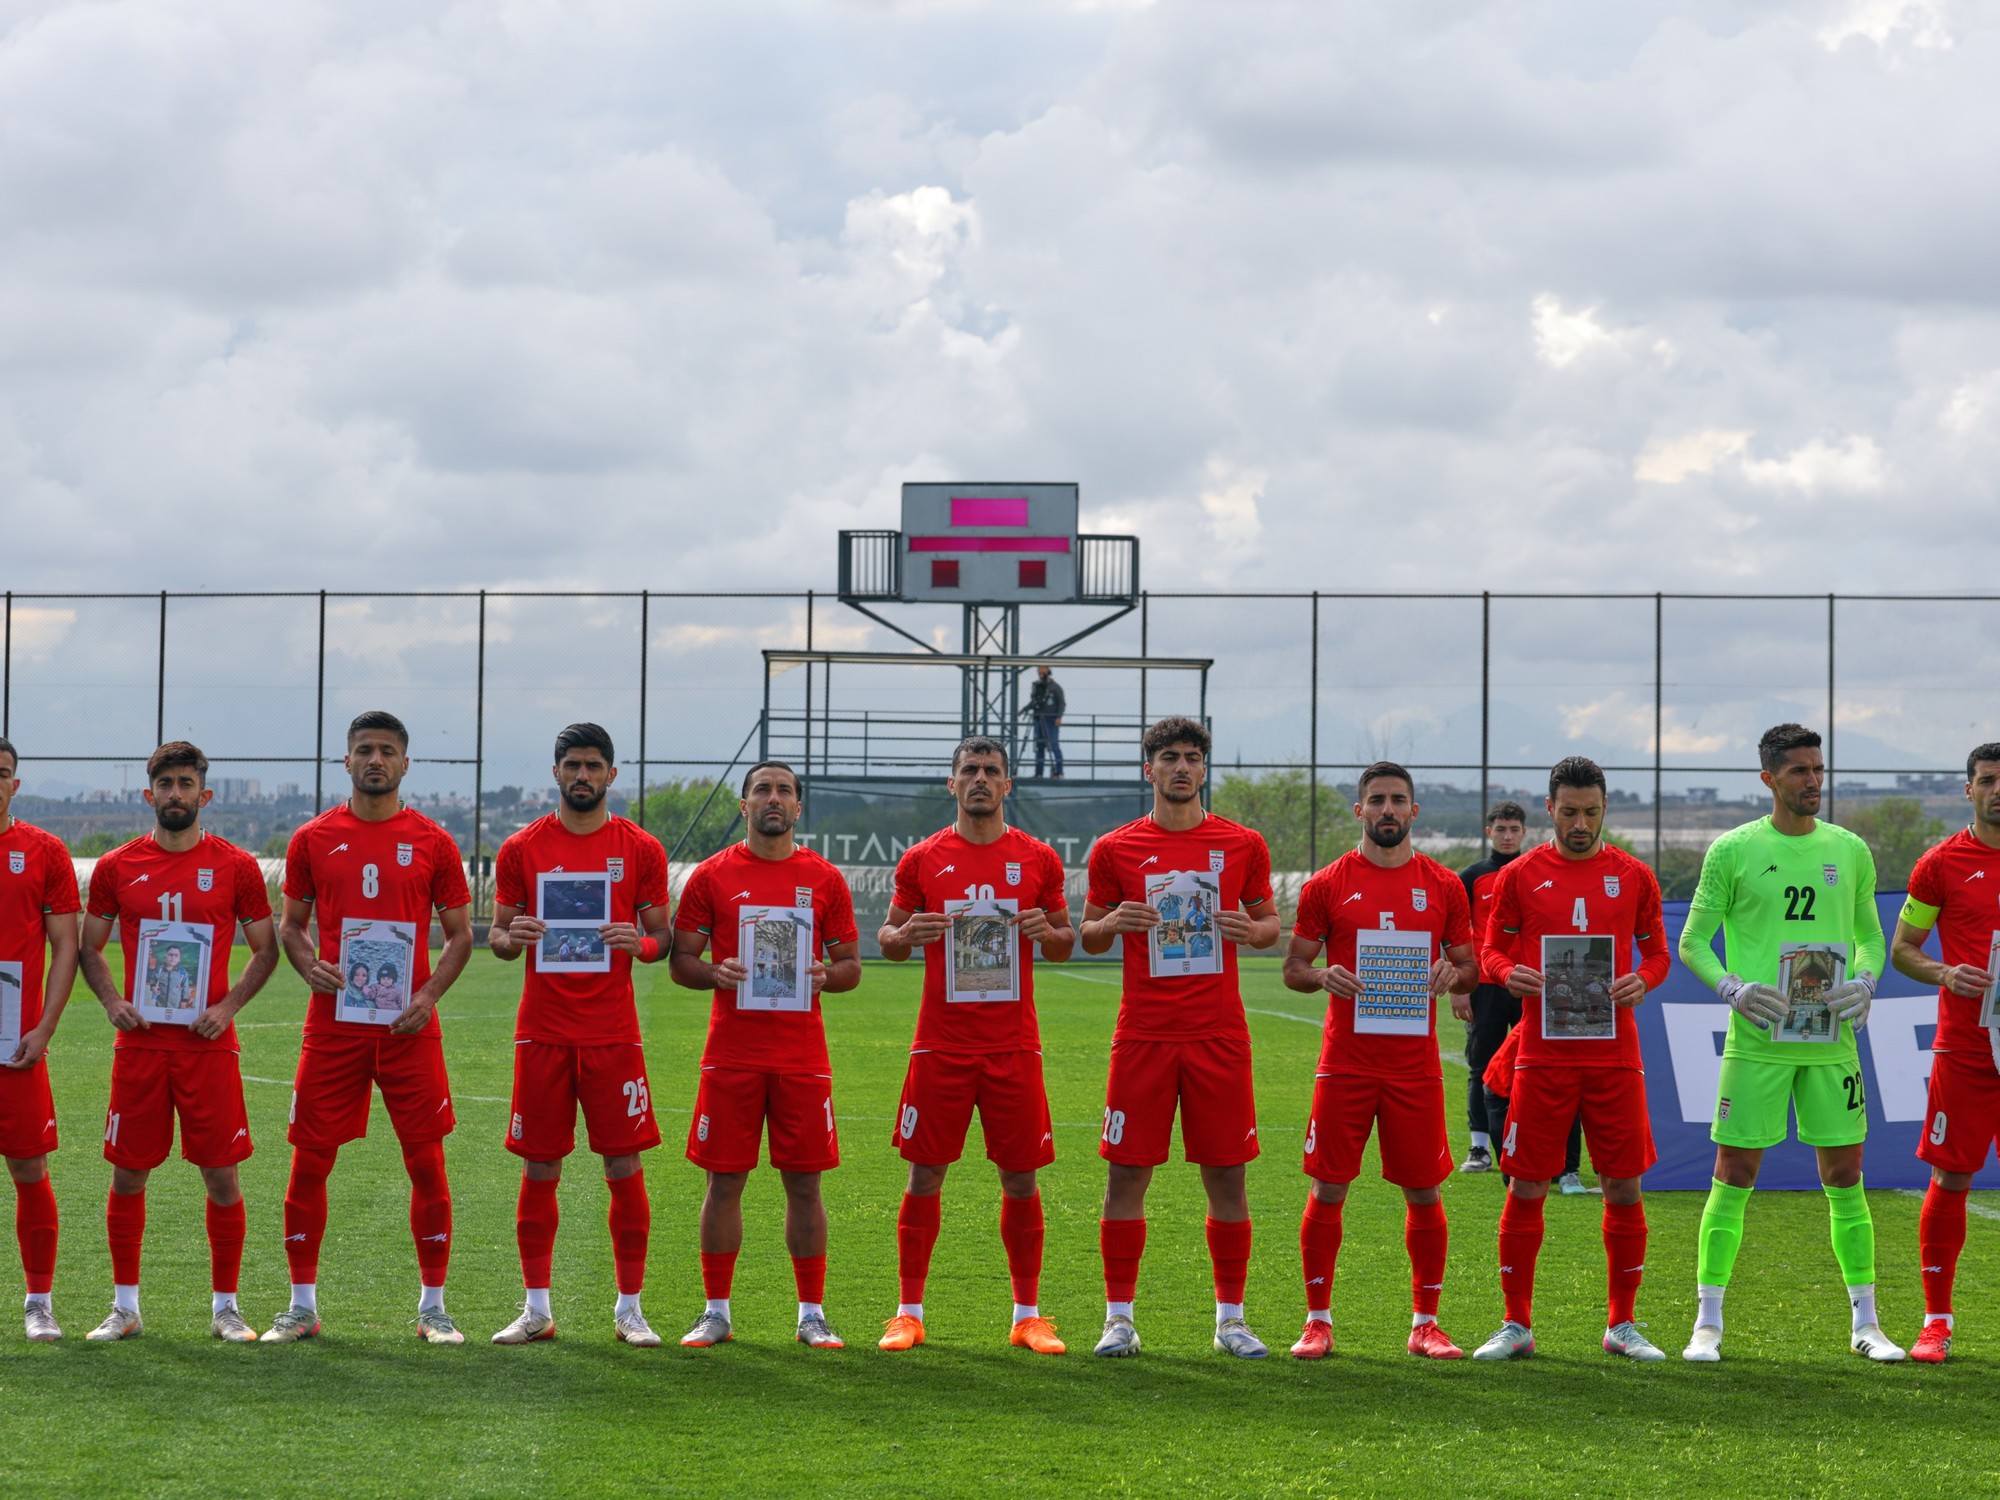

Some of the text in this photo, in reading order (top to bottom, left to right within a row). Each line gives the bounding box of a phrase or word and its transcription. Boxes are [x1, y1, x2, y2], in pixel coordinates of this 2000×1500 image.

[794, 832, 927, 862] TITAN
[362, 863, 379, 899] 8
[157, 891, 182, 922] 11
[1379, 911, 1395, 930] 5
[1572, 897, 1588, 932] 4
[1784, 885, 1816, 921] 22
[622, 1076, 649, 1117] 25
[1842, 1070, 1865, 1111] 22
[104, 1109, 120, 1147] 11
[1102, 1105, 1126, 1146] 28
[1502, 1121, 1518, 1157] 4
[1929, 1111, 1947, 1146] 9
